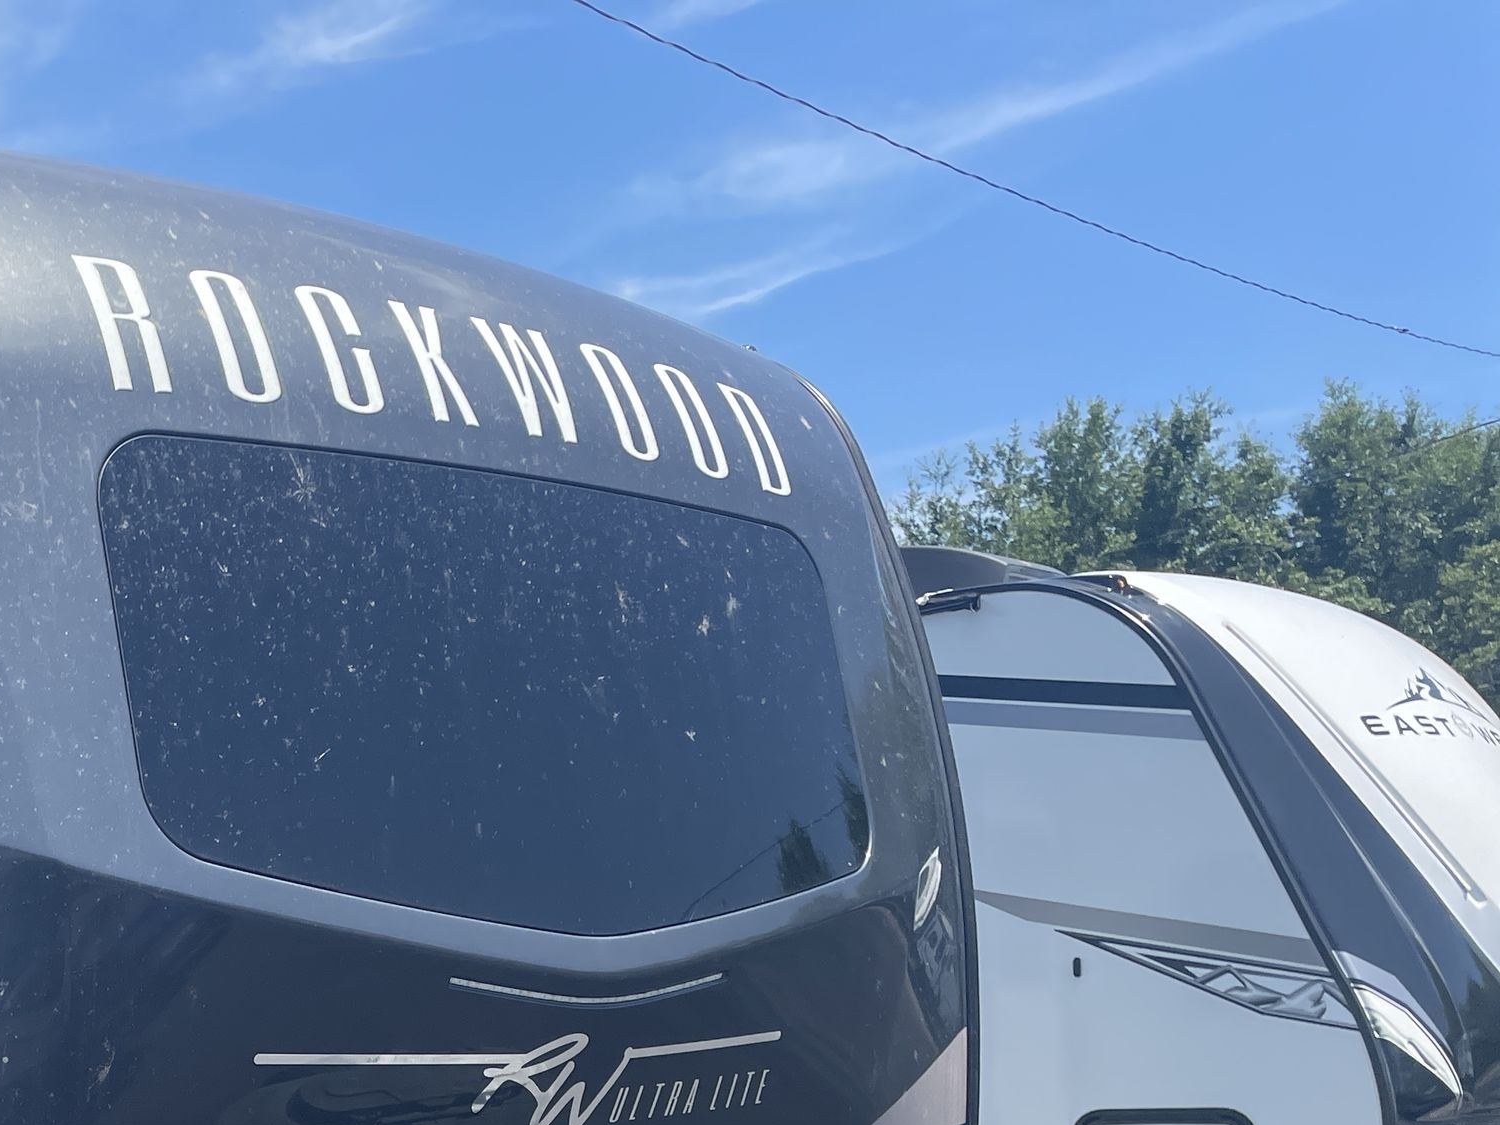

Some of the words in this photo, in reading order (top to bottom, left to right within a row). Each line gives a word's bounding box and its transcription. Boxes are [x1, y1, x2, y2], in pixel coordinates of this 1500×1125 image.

[71, 253, 792, 497] ROCKWOOD
[1359, 713, 1456, 737] EAST
[609, 1078, 700, 1123] ULTRA
[708, 1068, 771, 1111] LITE
